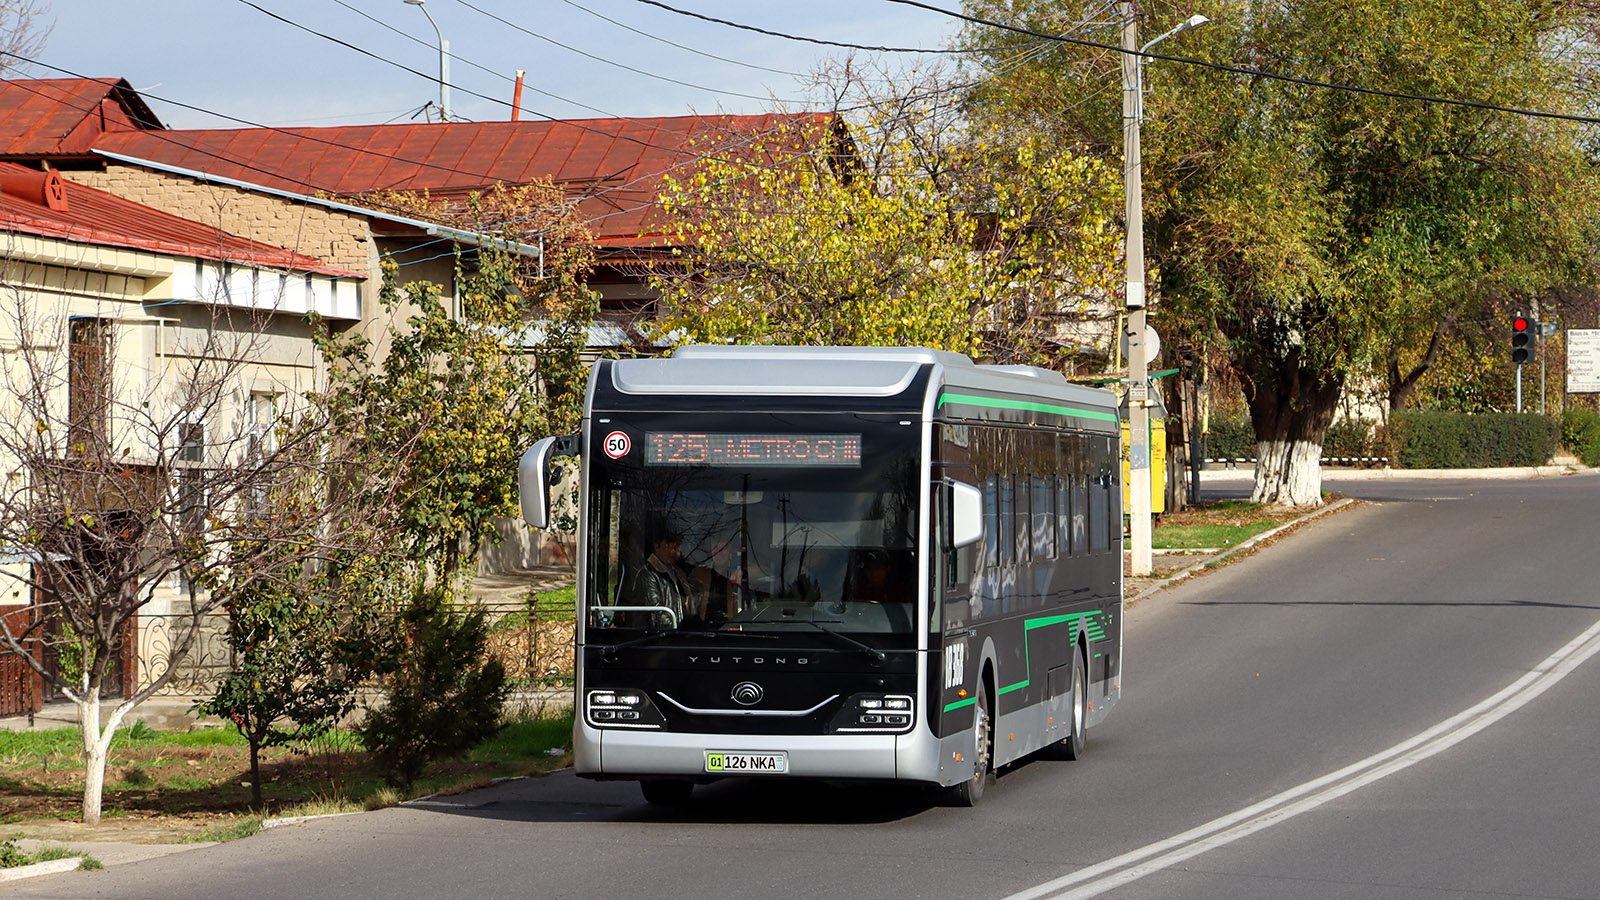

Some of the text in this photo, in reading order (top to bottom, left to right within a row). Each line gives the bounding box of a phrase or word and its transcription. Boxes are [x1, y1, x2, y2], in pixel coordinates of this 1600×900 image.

[608, 439, 626, 452] 50
[652, 434, 707, 462] 125
[727, 440, 811, 458] METRO
[689, 656, 809, 665] YUTONG
[710, 756, 776, 770] 01 126 NKA
